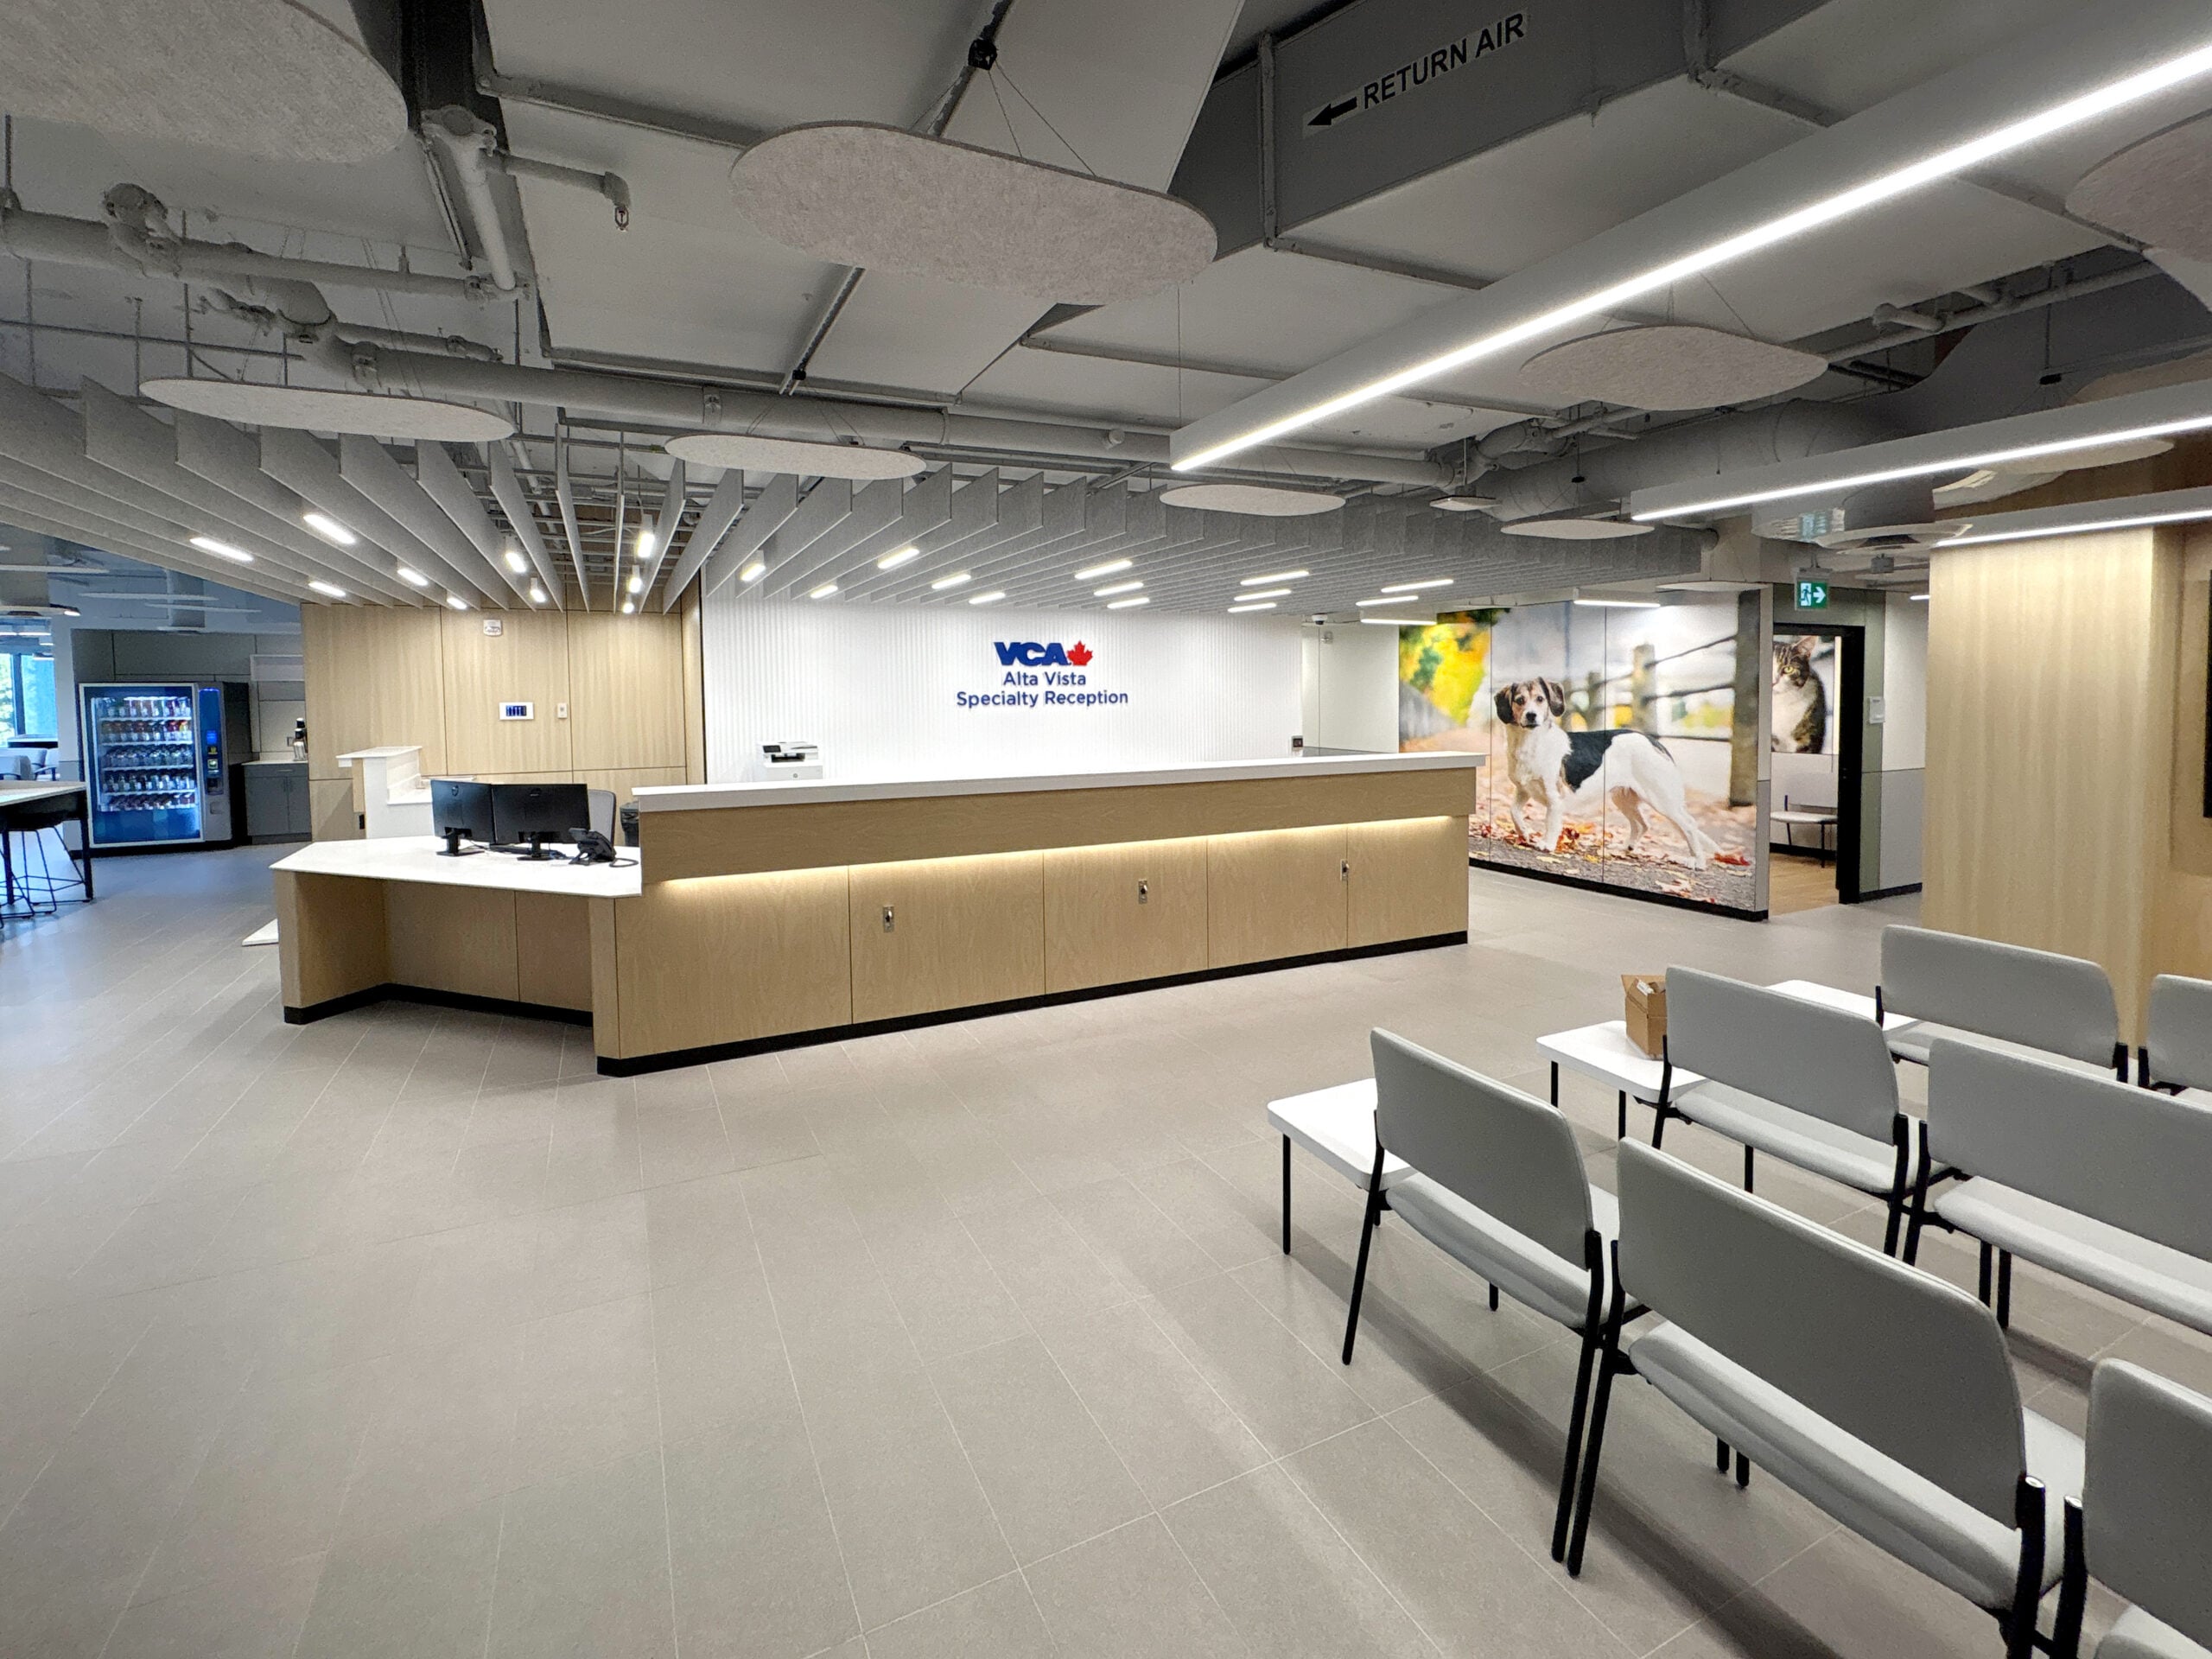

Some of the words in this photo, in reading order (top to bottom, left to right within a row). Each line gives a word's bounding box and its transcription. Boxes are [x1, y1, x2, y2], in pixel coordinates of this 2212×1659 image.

[1363, 38, 1467, 109] RETURN
[1475, 13, 1525, 59] AIR
[994, 641, 1069, 666] VCA
[1002, 671, 1039, 686] Alta
[1044, 671, 1087, 686] Vista
[956, 690, 1039, 709] Specialty
[1044, 690, 1128, 707] Reception
